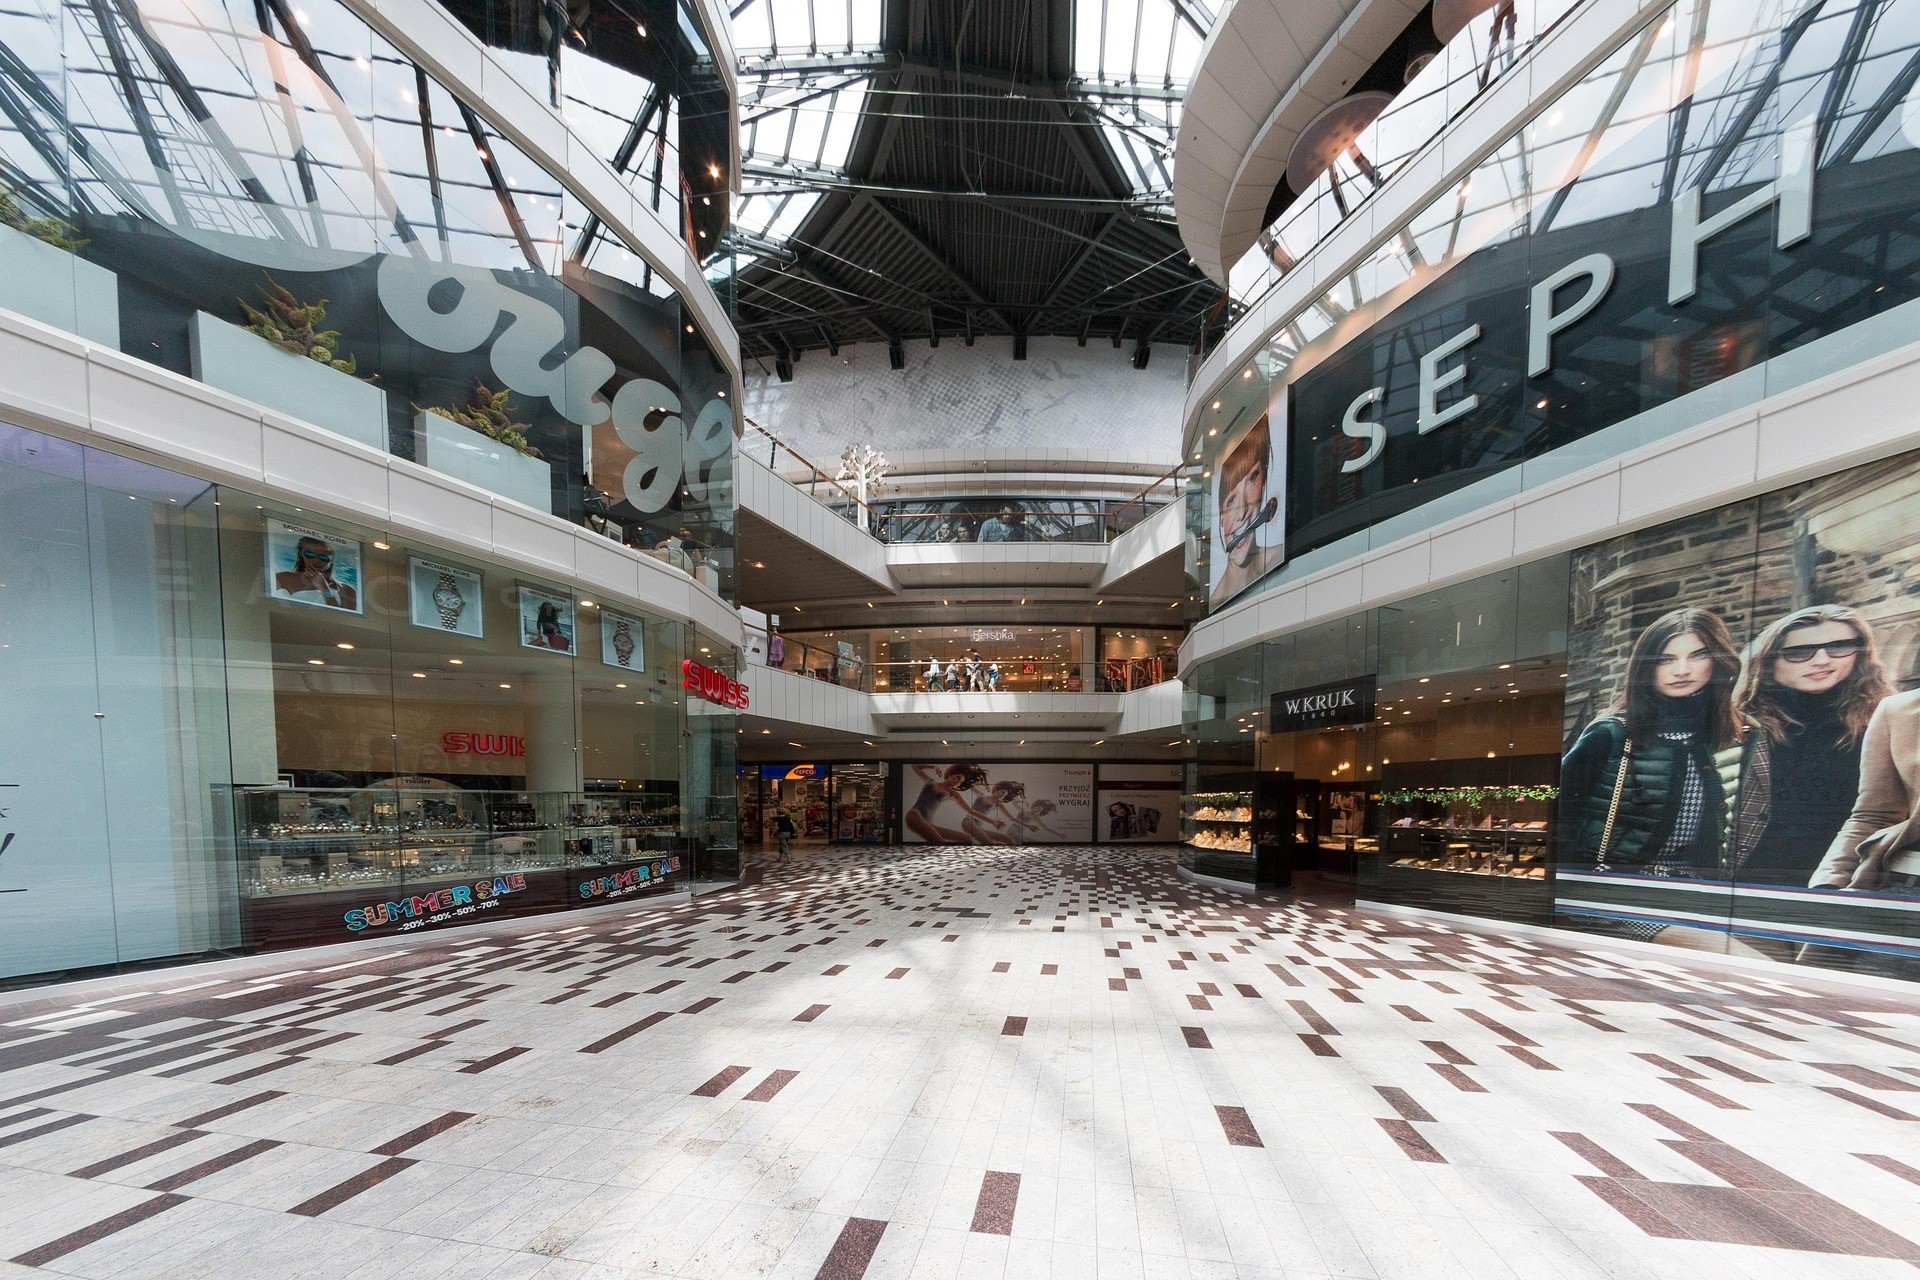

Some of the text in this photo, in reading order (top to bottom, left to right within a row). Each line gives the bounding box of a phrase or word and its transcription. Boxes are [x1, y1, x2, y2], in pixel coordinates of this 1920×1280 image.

[1342, 74, 1920, 476] SEPH
[283, 523, 347, 545] MICHAEL KORS
[421, 560, 471, 578] MICHAEL KORS
[972, 630, 1015, 641] Bershka
[683, 659, 749, 709] SWISS
[1302, 710, 1336, 720] 1840
[579, 856, 682, 900] SUMMER SALE
[344, 872, 527, 932] SUMMER SALE
[397, 899, 500, 932] -20% -30% -50% -70%
